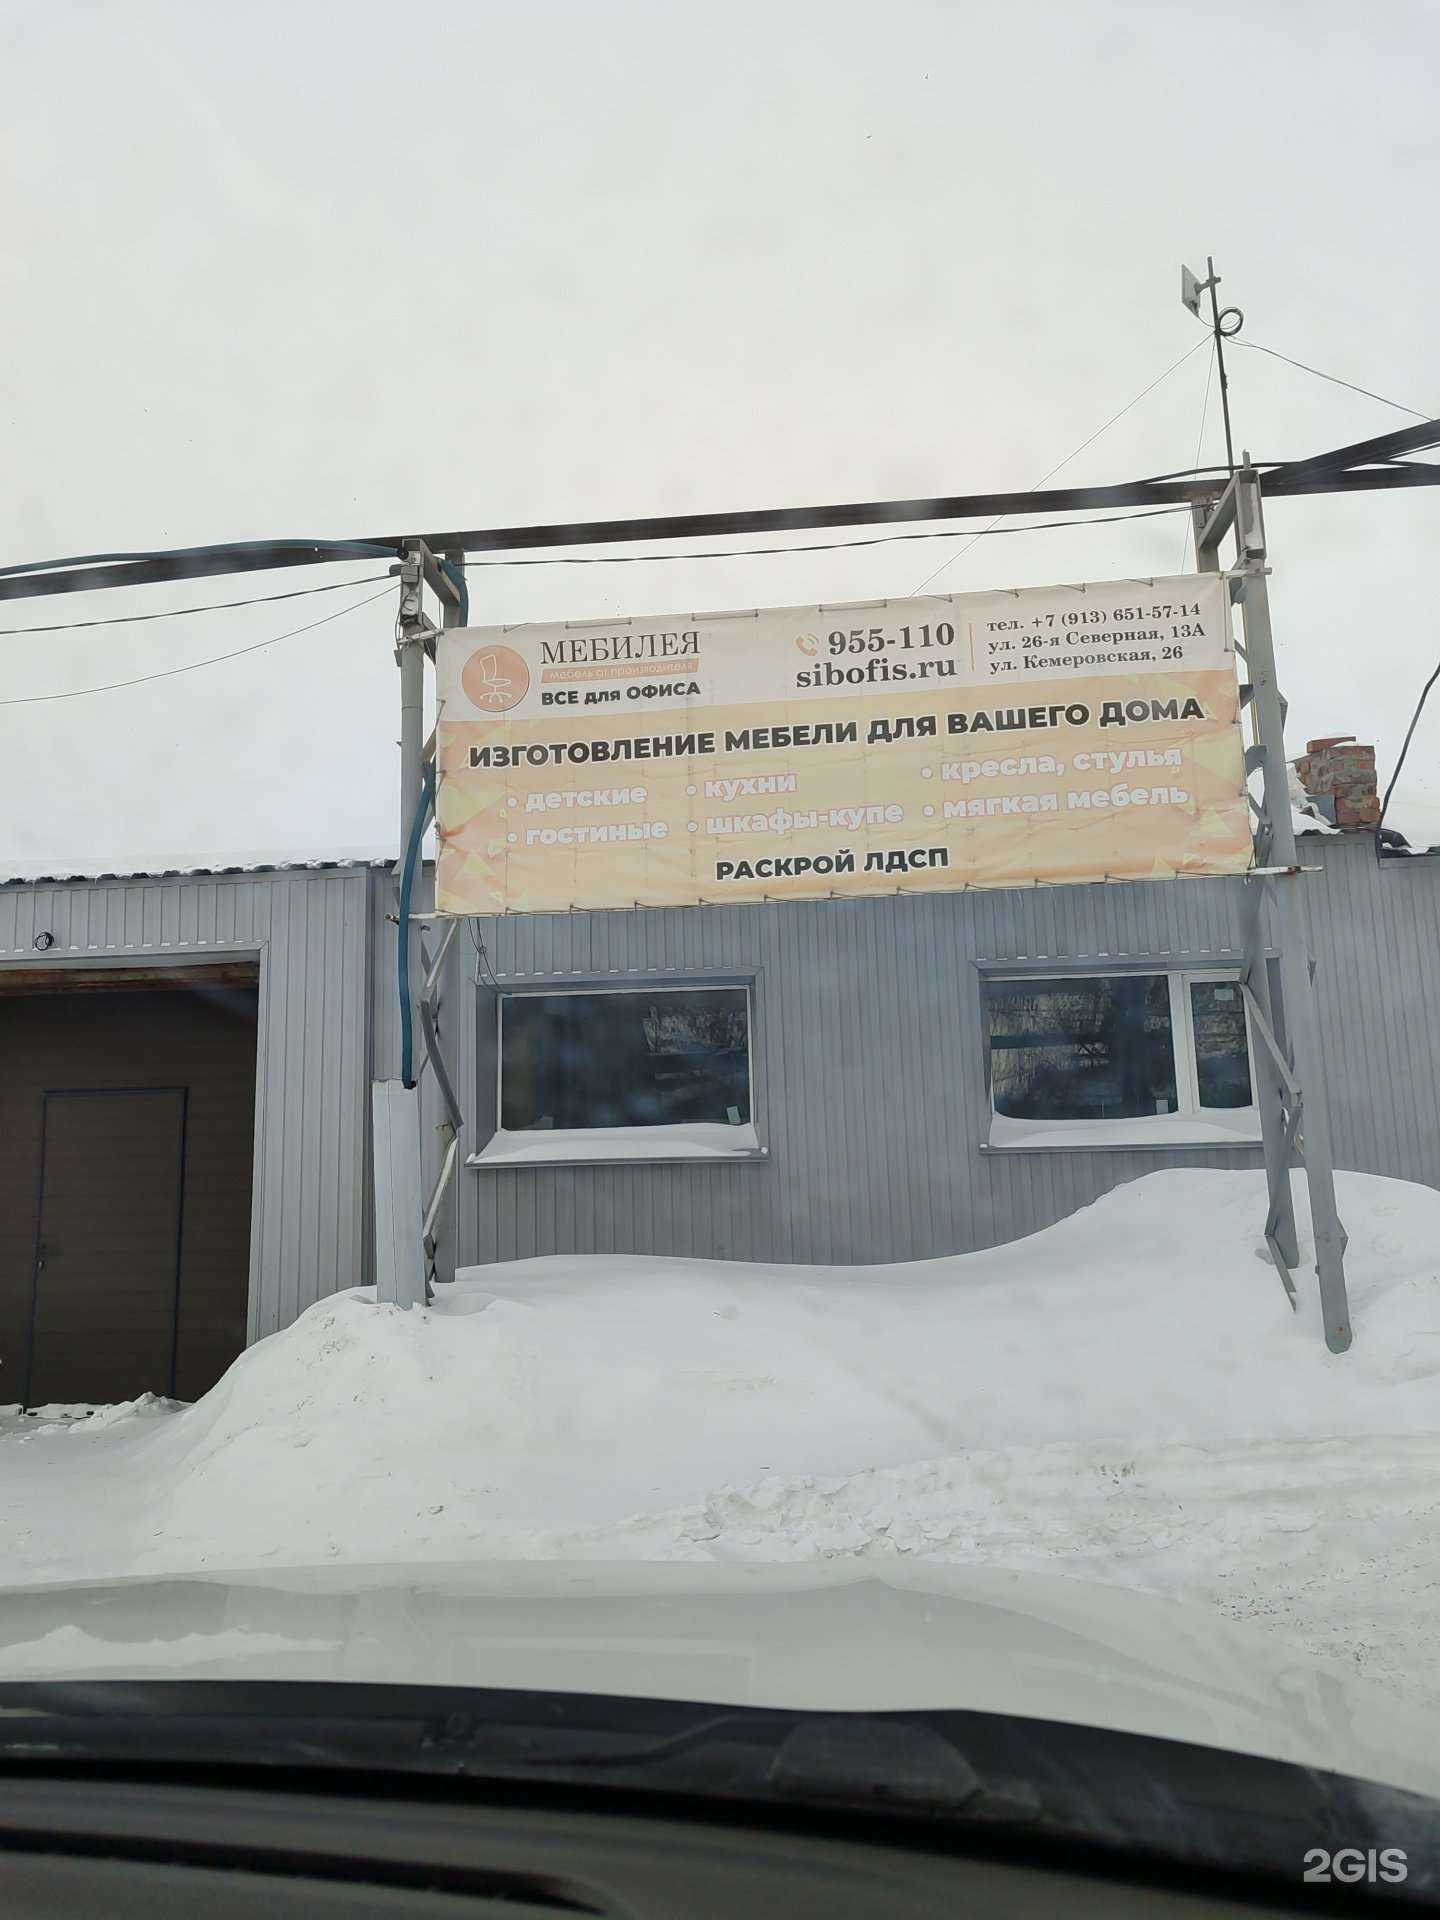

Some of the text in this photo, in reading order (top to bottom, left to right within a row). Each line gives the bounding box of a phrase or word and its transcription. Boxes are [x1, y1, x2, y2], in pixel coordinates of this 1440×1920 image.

[987, 603, 1201, 633] тел. +7 (913) 651-57-14
[540, 631, 700, 664] МЕБИЛЕЯ
[828, 622, 955, 655] 955-110
[988, 638, 1016, 656] ул.
[1022, 634, 1060, 649] 26-я
[1066, 627, 1164, 648] Северная,
[796, 657, 957, 688] sibofis.ru
[989, 645, 1184, 675] ул. Кемеровская, 26
[541, 681, 701, 706] ВСЕ для ОФИСА
[469, 698, 1205, 768] ИЗГОТОВЛЕНИЕ МЕБЕЛИ ДЛЯ ВАШЕГО ДОМА
[942, 748, 1183, 783] кресла, стулья
[525, 785, 648, 813] детские
[704, 773, 797, 802] кухни
[942, 783, 1190, 818] мягкая мебель
[526, 820, 669, 846] гостиные
[705, 802, 905, 835] шкафы-купе
[716, 847, 949, 882] РАСКРОЙ ЛДСП
